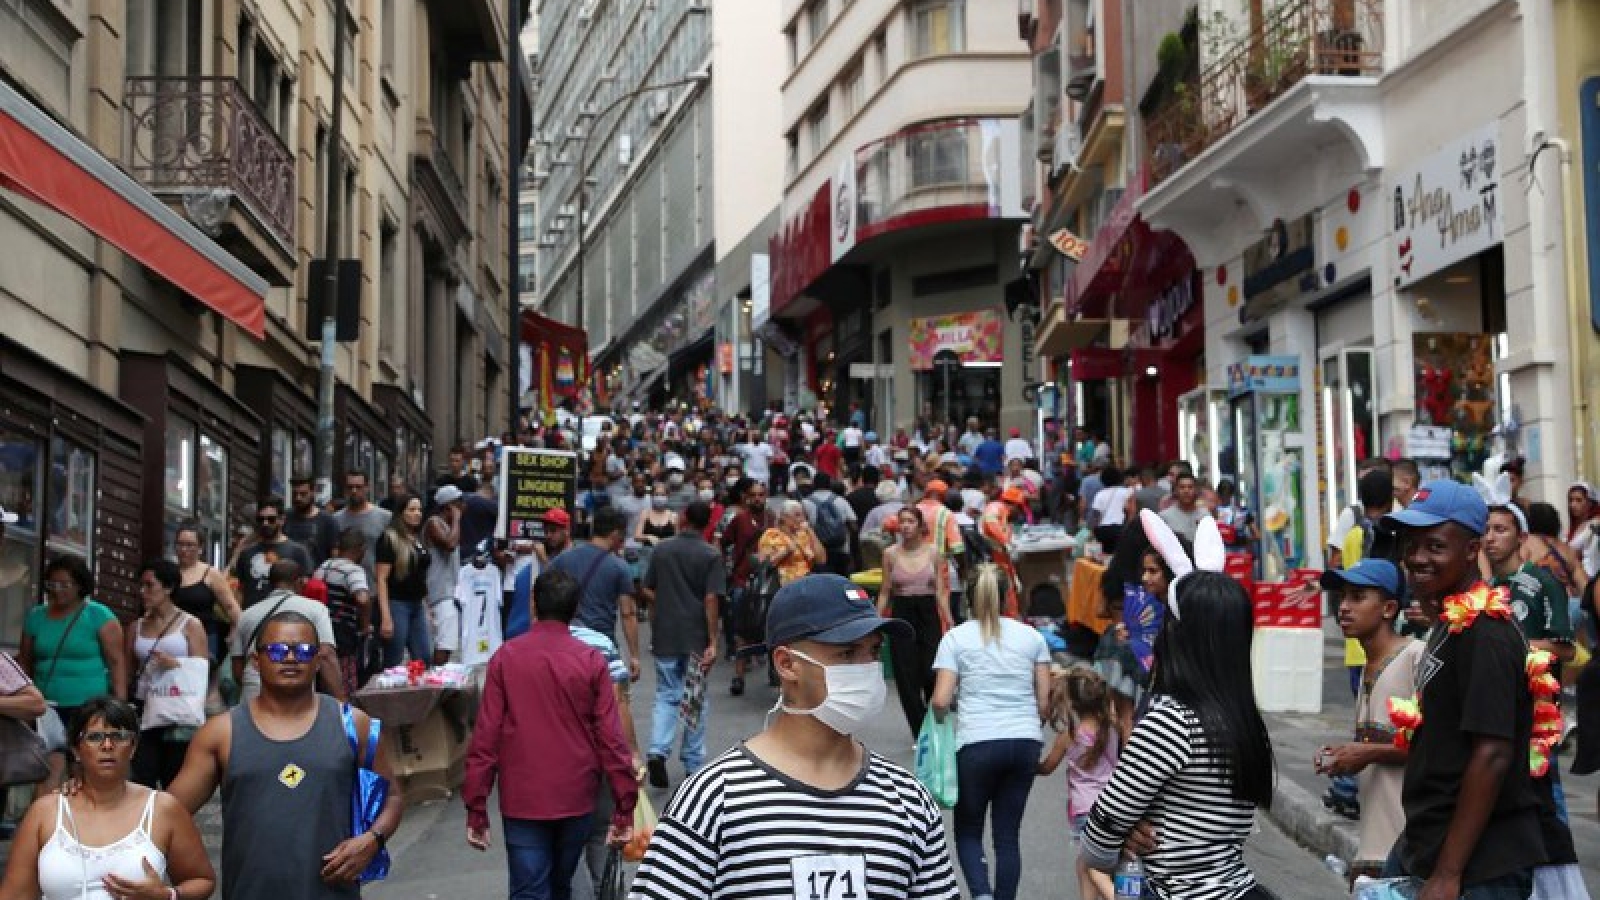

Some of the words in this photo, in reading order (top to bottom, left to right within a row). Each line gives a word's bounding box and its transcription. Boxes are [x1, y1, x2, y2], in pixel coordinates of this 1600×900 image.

[1407, 172, 1444, 230] Ana
[516, 453, 537, 467] SEX
[540, 455, 569, 469] SHOP
[517, 478, 565, 494] LINGERIE
[516, 495, 564, 510] REVENDA
[474, 589, 487, 627] 7
[807, 869, 858, 899] 171
